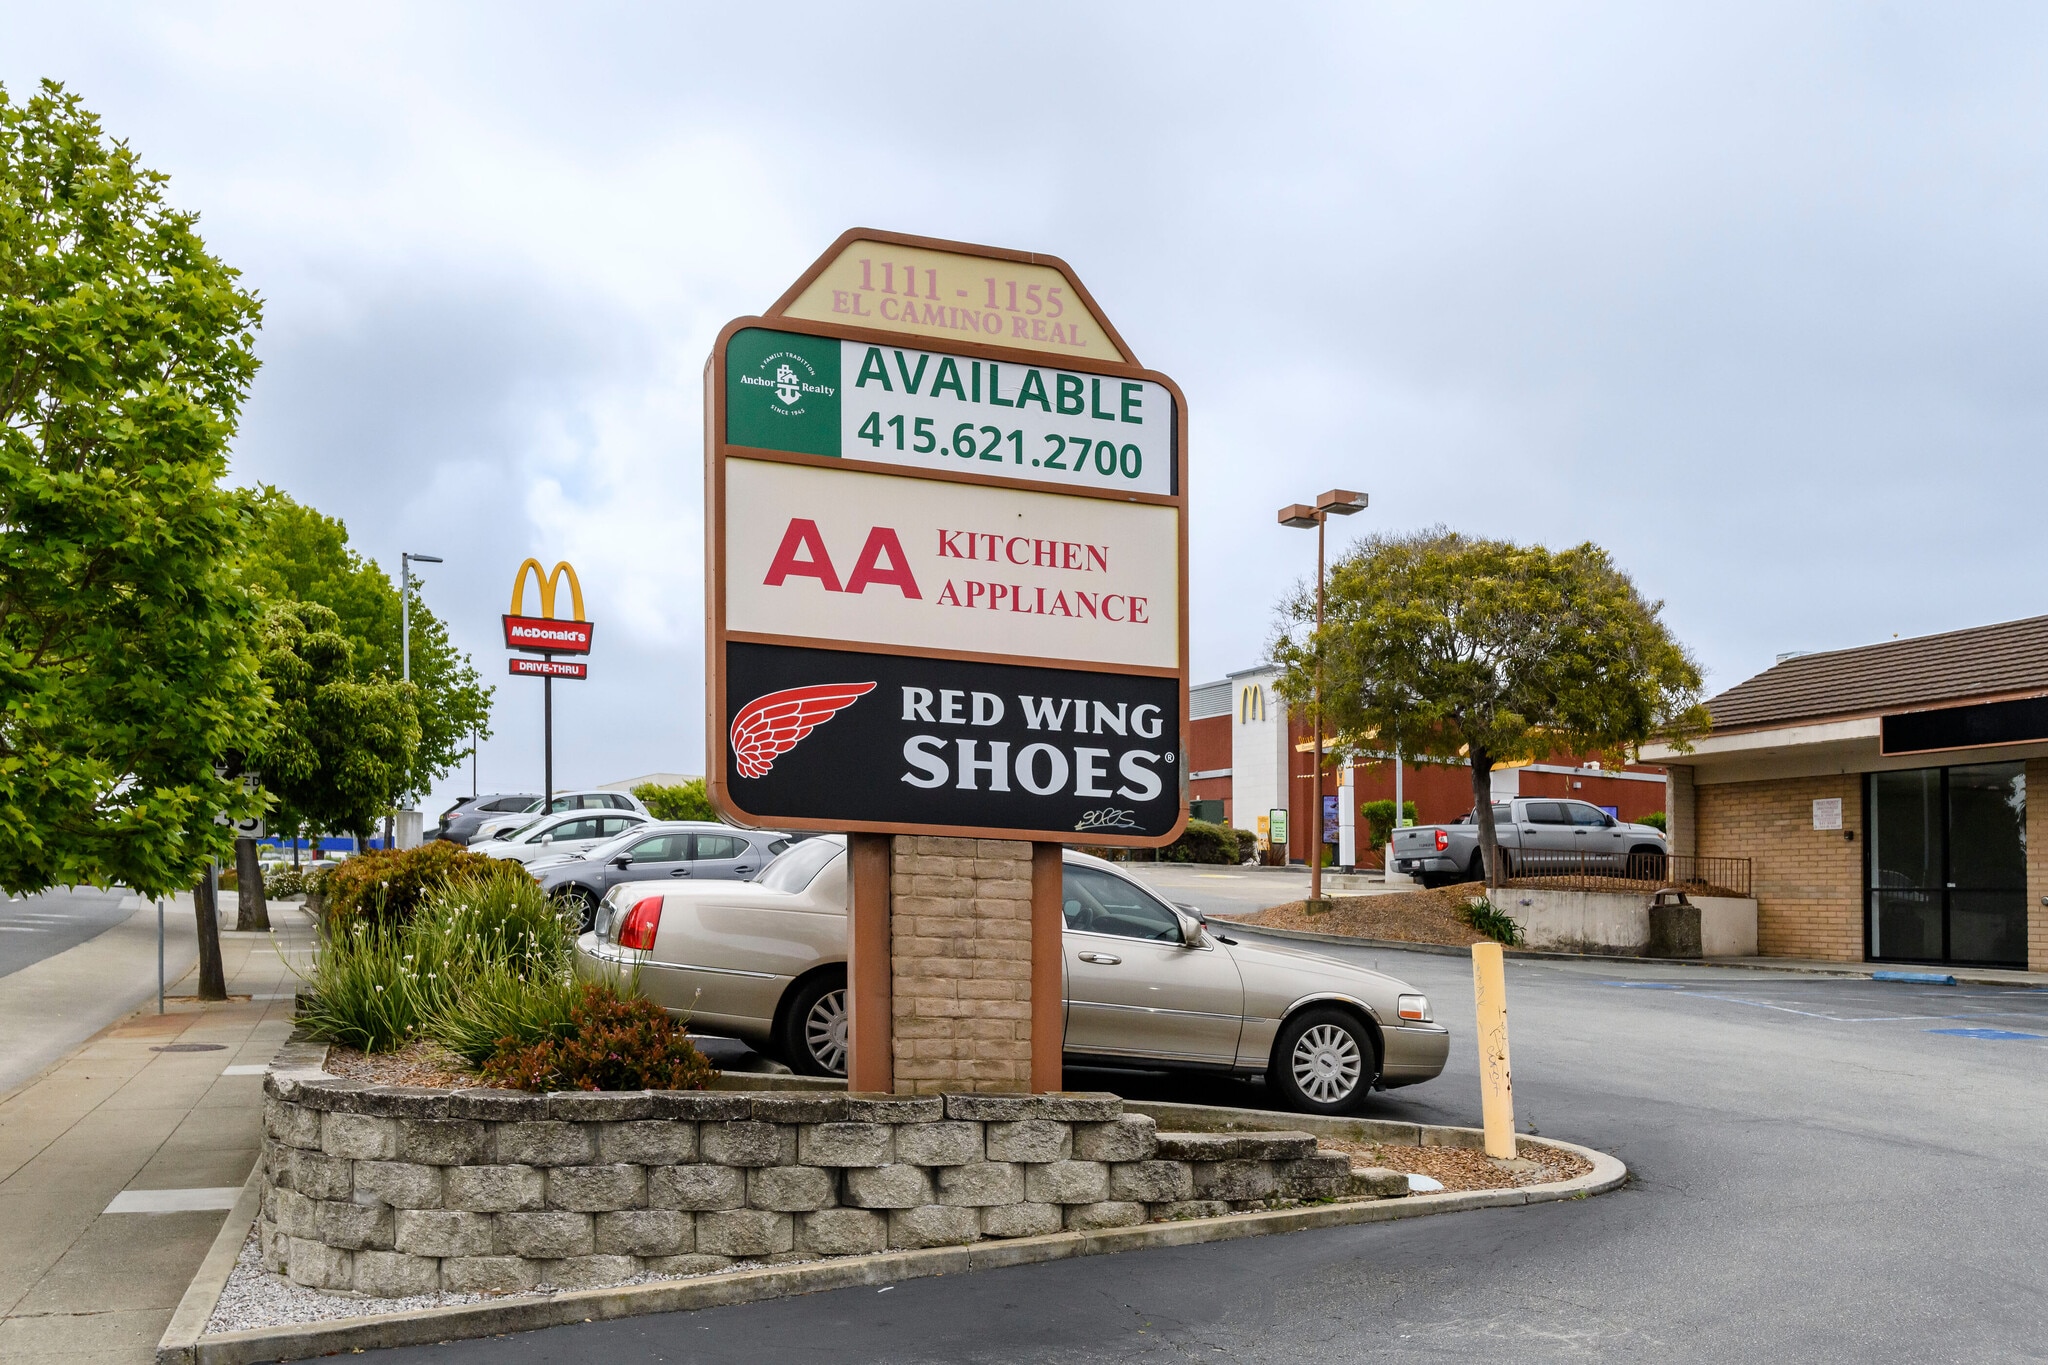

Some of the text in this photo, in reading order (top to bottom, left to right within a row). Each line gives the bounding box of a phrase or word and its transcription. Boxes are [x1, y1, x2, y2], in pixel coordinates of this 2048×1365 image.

[859, 259, 941, 301] 1111
[984, 278, 1064, 318] 1155
[831, 290, 1087, 347] EL CAMINO REAL
[740, 374, 835, 397] Anchor Realty
[763, 352, 783, 364] FAMILY
[785, 351, 815, 376] TRADITION
[855, 347, 1144, 425] AVAILABLE
[770, 404, 788, 415] SINCE
[857, 411, 1143, 479] 415.621.2700
[762, 517, 923, 600] AA
[936, 528, 1109, 573] KITCHEN
[936, 579, 1150, 625] APPLIANCE
[511, 626, 586, 642] McDonald's
[519, 661, 579, 674] DRIVE-THRU
[901, 686, 1164, 739] RED WING
